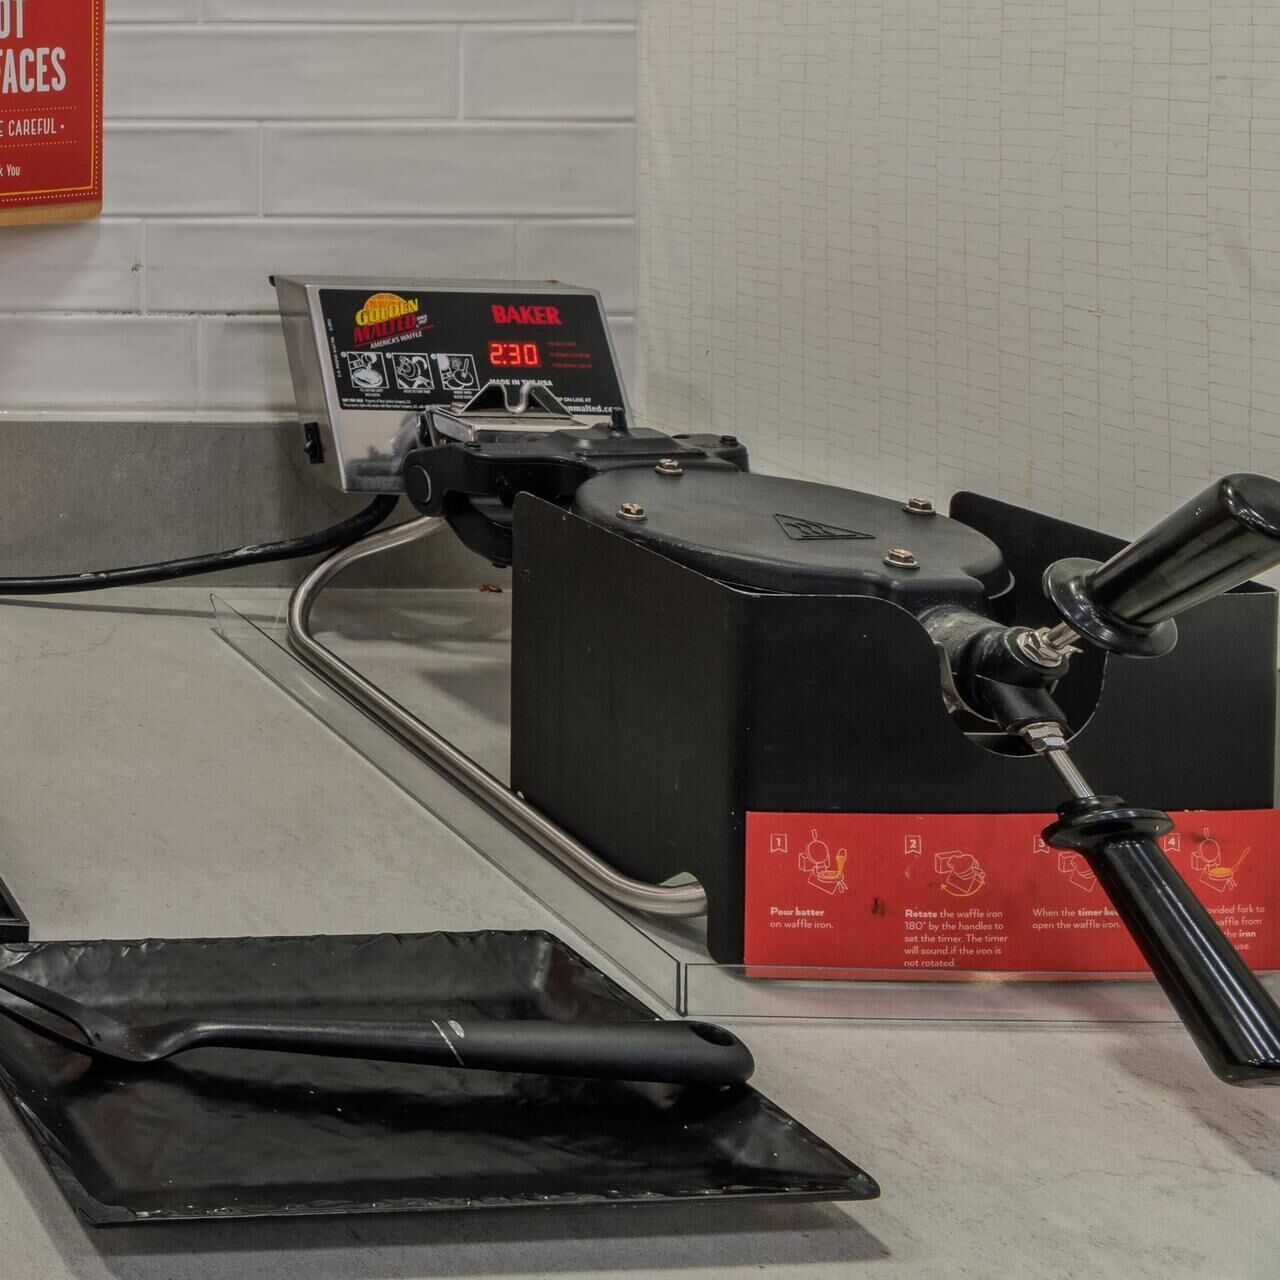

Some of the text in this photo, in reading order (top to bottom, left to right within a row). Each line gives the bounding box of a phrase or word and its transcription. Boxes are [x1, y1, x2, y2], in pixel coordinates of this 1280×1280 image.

[8, 118, 56, 136] CAREFUL
[6, 163, 21, 177] You
[355, 298, 419, 326] GOLDEN
[491, 304, 562, 325] BAKER
[353, 313, 417, 343] MALTED
[370, 330, 423, 349] AMERICA'S WAFFLE
[910, 840, 917, 848] 2
[1168, 837, 1176, 846] 4
[770, 907, 824, 917] Pour batter
[905, 909, 1003, 918] Rotate the waffle iron
[1033, 908, 1102, 917] When the timer
[1237, 904, 1254, 913] fork
[784, 919, 812, 929] waffle
[815, 920, 834, 929] iron.
[928, 921, 992, 932] by the handles
[1032, 920, 1121, 931] open the waffle iron.
[1242, 917, 1262, 926] from
[904, 934, 1008, 943] set the timer. The timer
[1239, 930, 1256, 938] iron
[904, 946, 992, 955] will sound the iron
[904, 958, 956, 968] not rotated.
